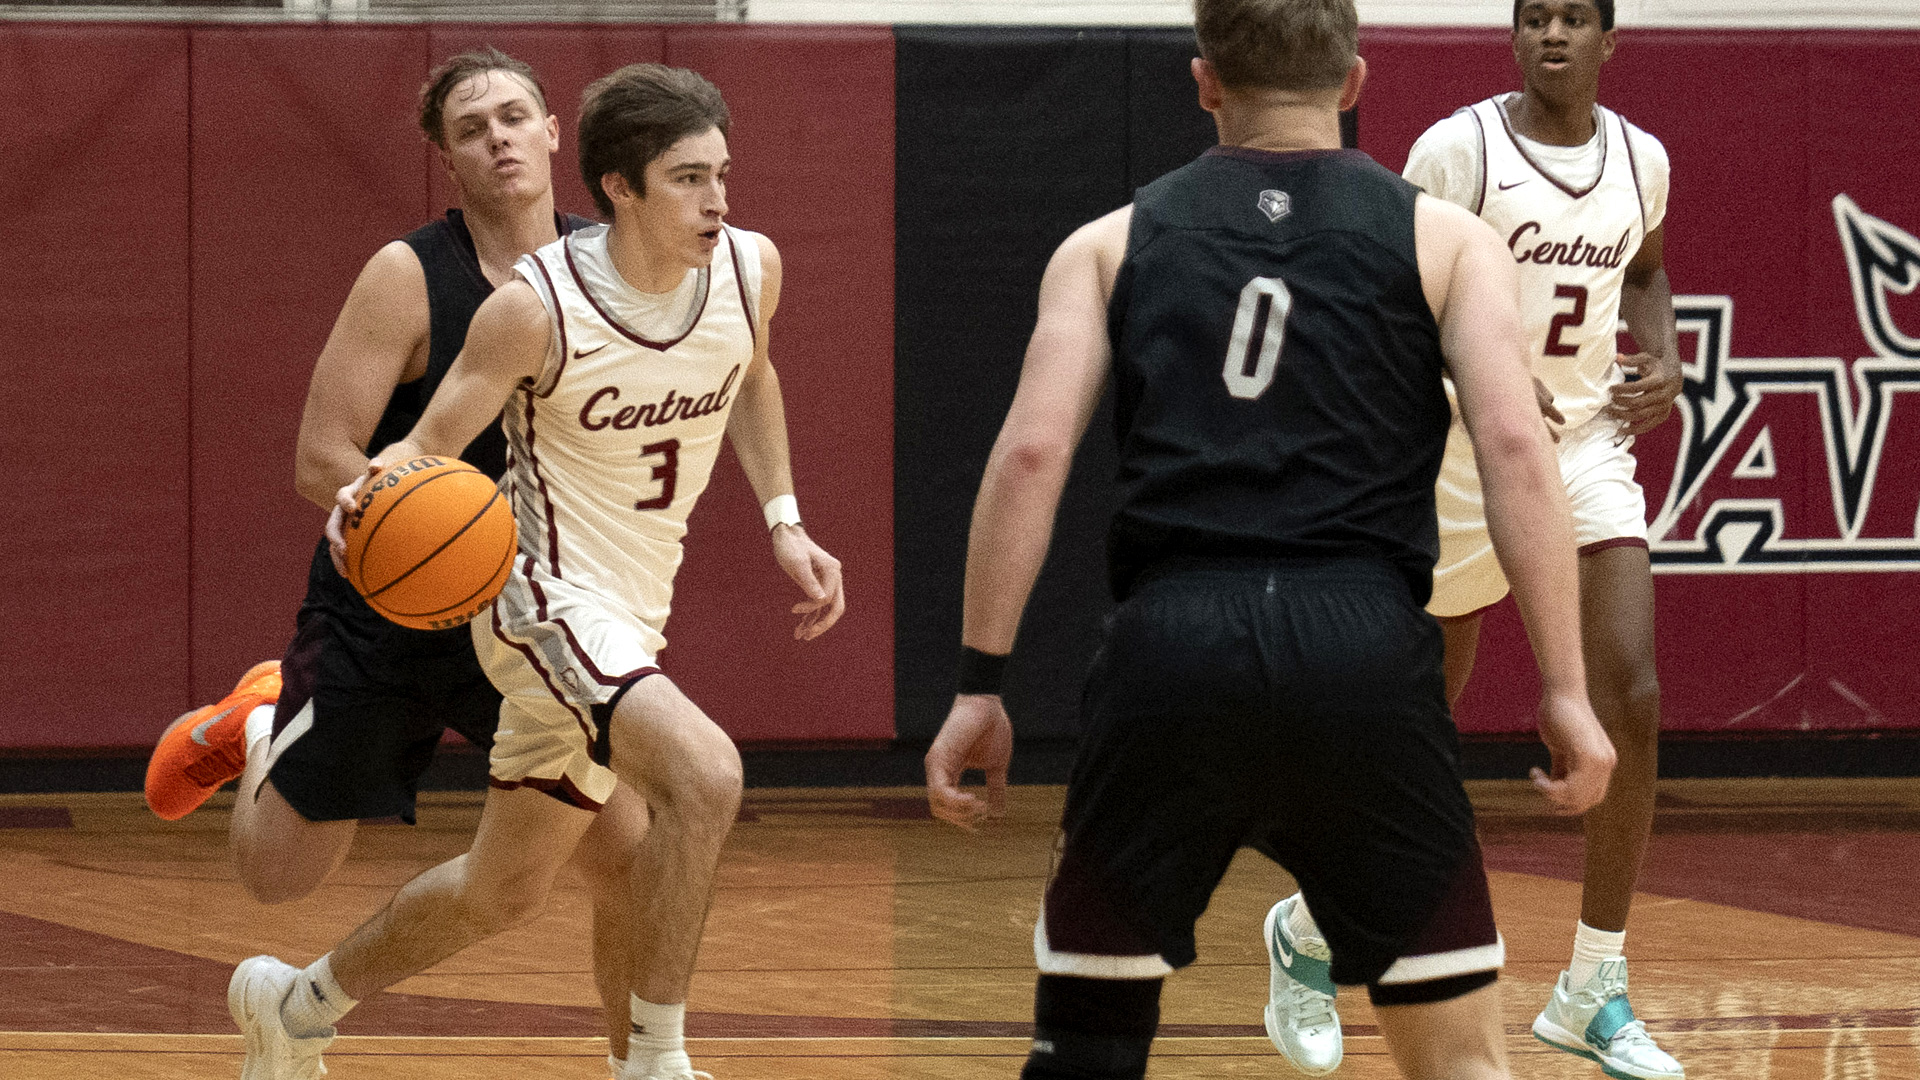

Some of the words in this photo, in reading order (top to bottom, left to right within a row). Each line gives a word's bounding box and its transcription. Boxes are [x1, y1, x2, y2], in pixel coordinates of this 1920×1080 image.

[1507, 220, 1631, 269] Central
[1222, 276, 1293, 400] 0
[1543, 283, 1589, 357] 2
[578, 363, 741, 432] Central
[634, 437, 681, 511] 3
